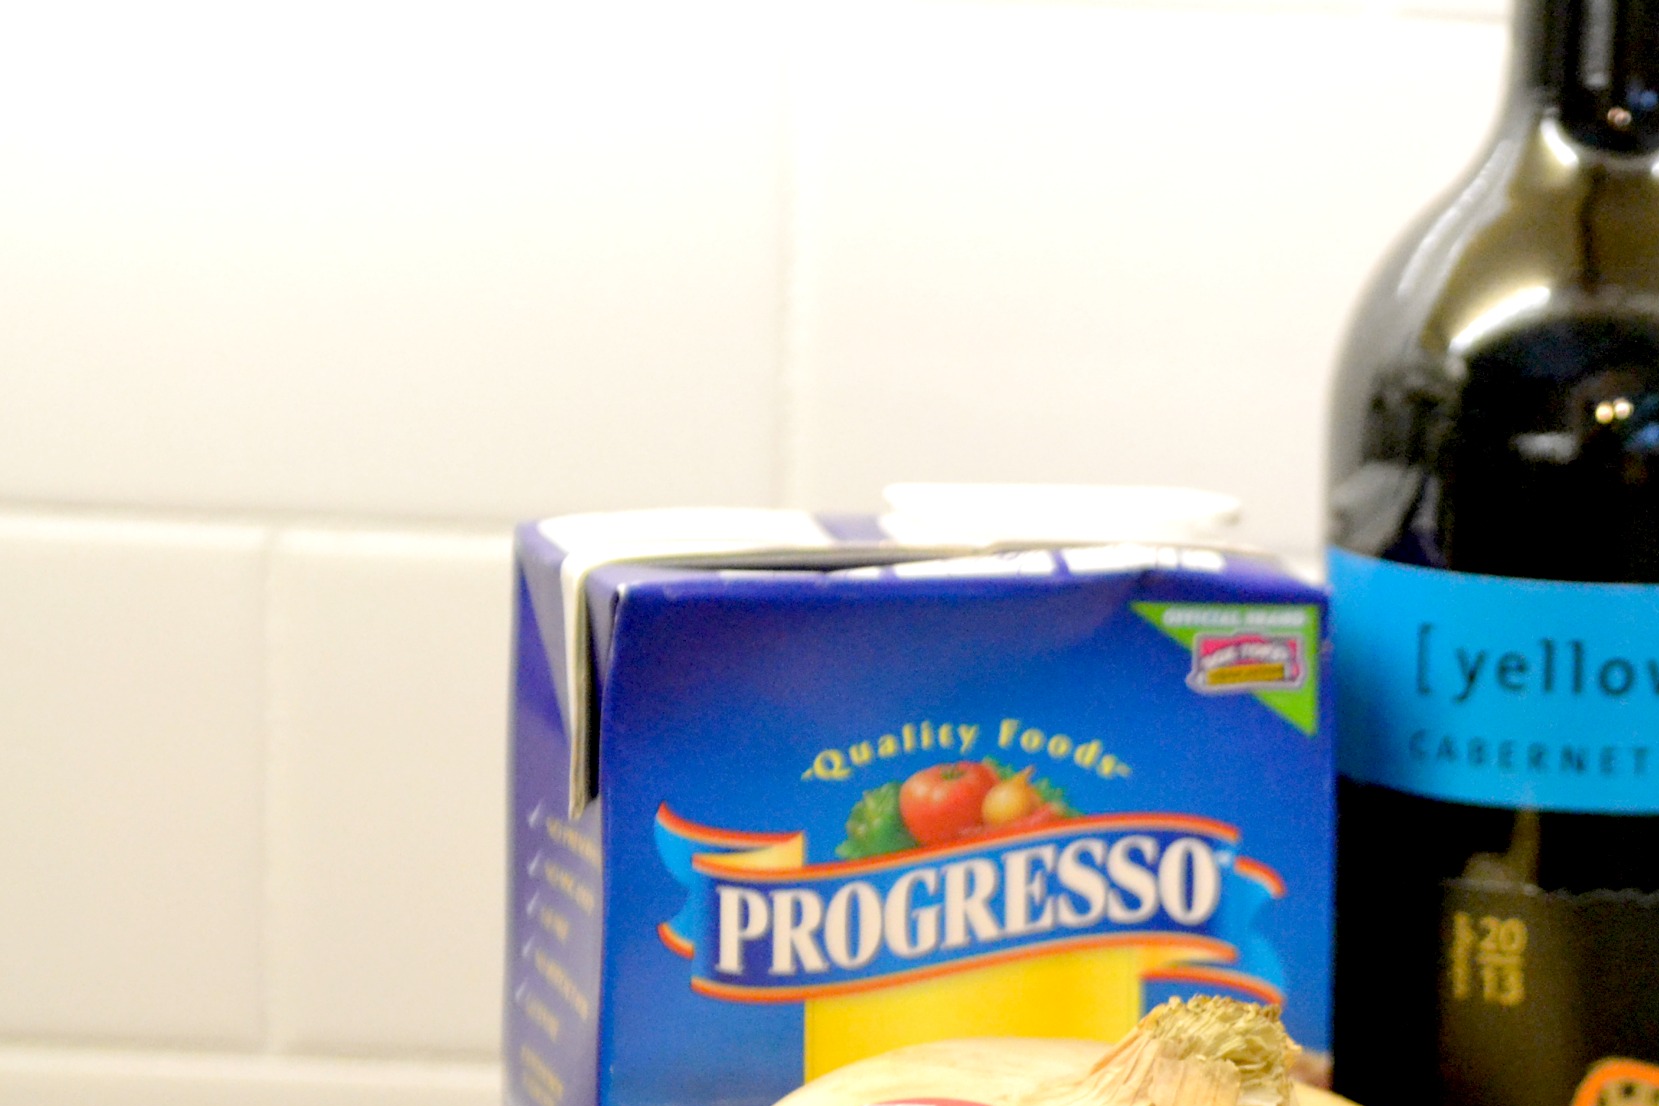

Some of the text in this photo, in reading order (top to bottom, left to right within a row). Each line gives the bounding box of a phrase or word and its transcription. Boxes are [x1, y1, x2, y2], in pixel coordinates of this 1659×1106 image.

[801, 718, 1122, 781] Quality Foods
[1408, 731, 1649, 776] CABERNET
[716, 836, 1222, 976] PROGRESSO
